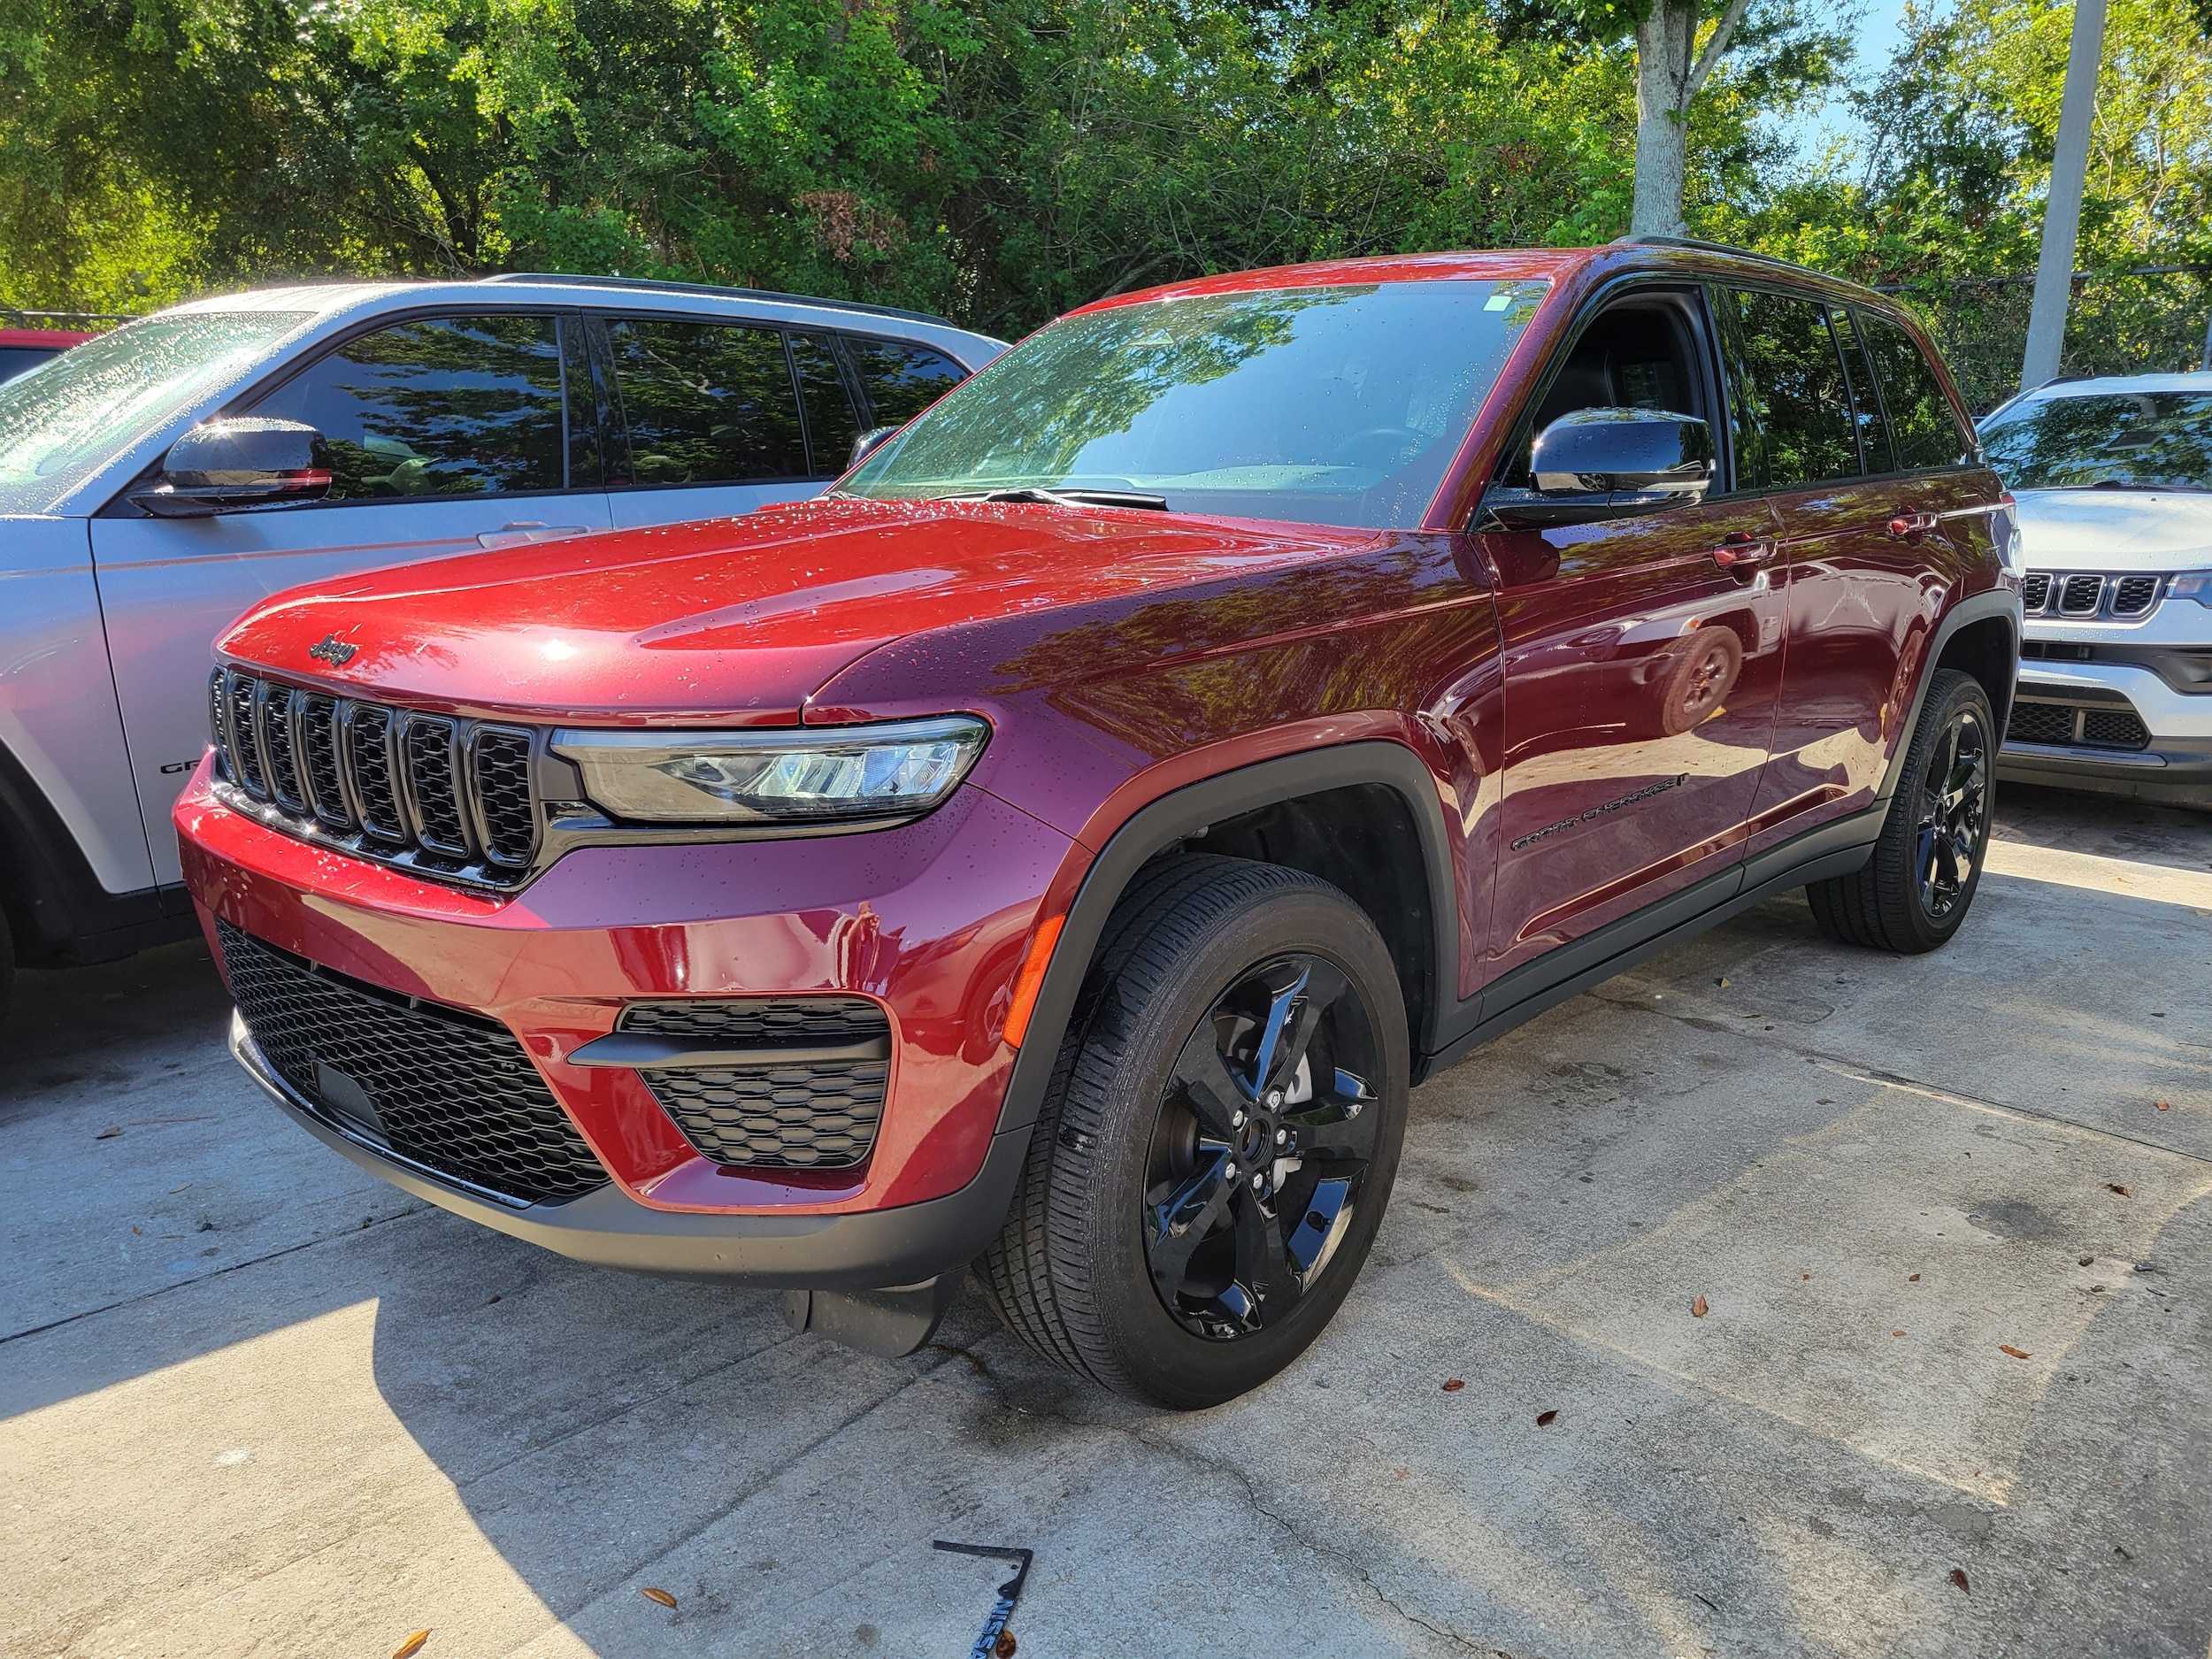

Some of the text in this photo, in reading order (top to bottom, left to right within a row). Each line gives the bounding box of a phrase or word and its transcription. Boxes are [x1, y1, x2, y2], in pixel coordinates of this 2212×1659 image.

[309, 634, 358, 666] Jeep
[1510, 778, 1676, 851] GRAND CHEROKEE
